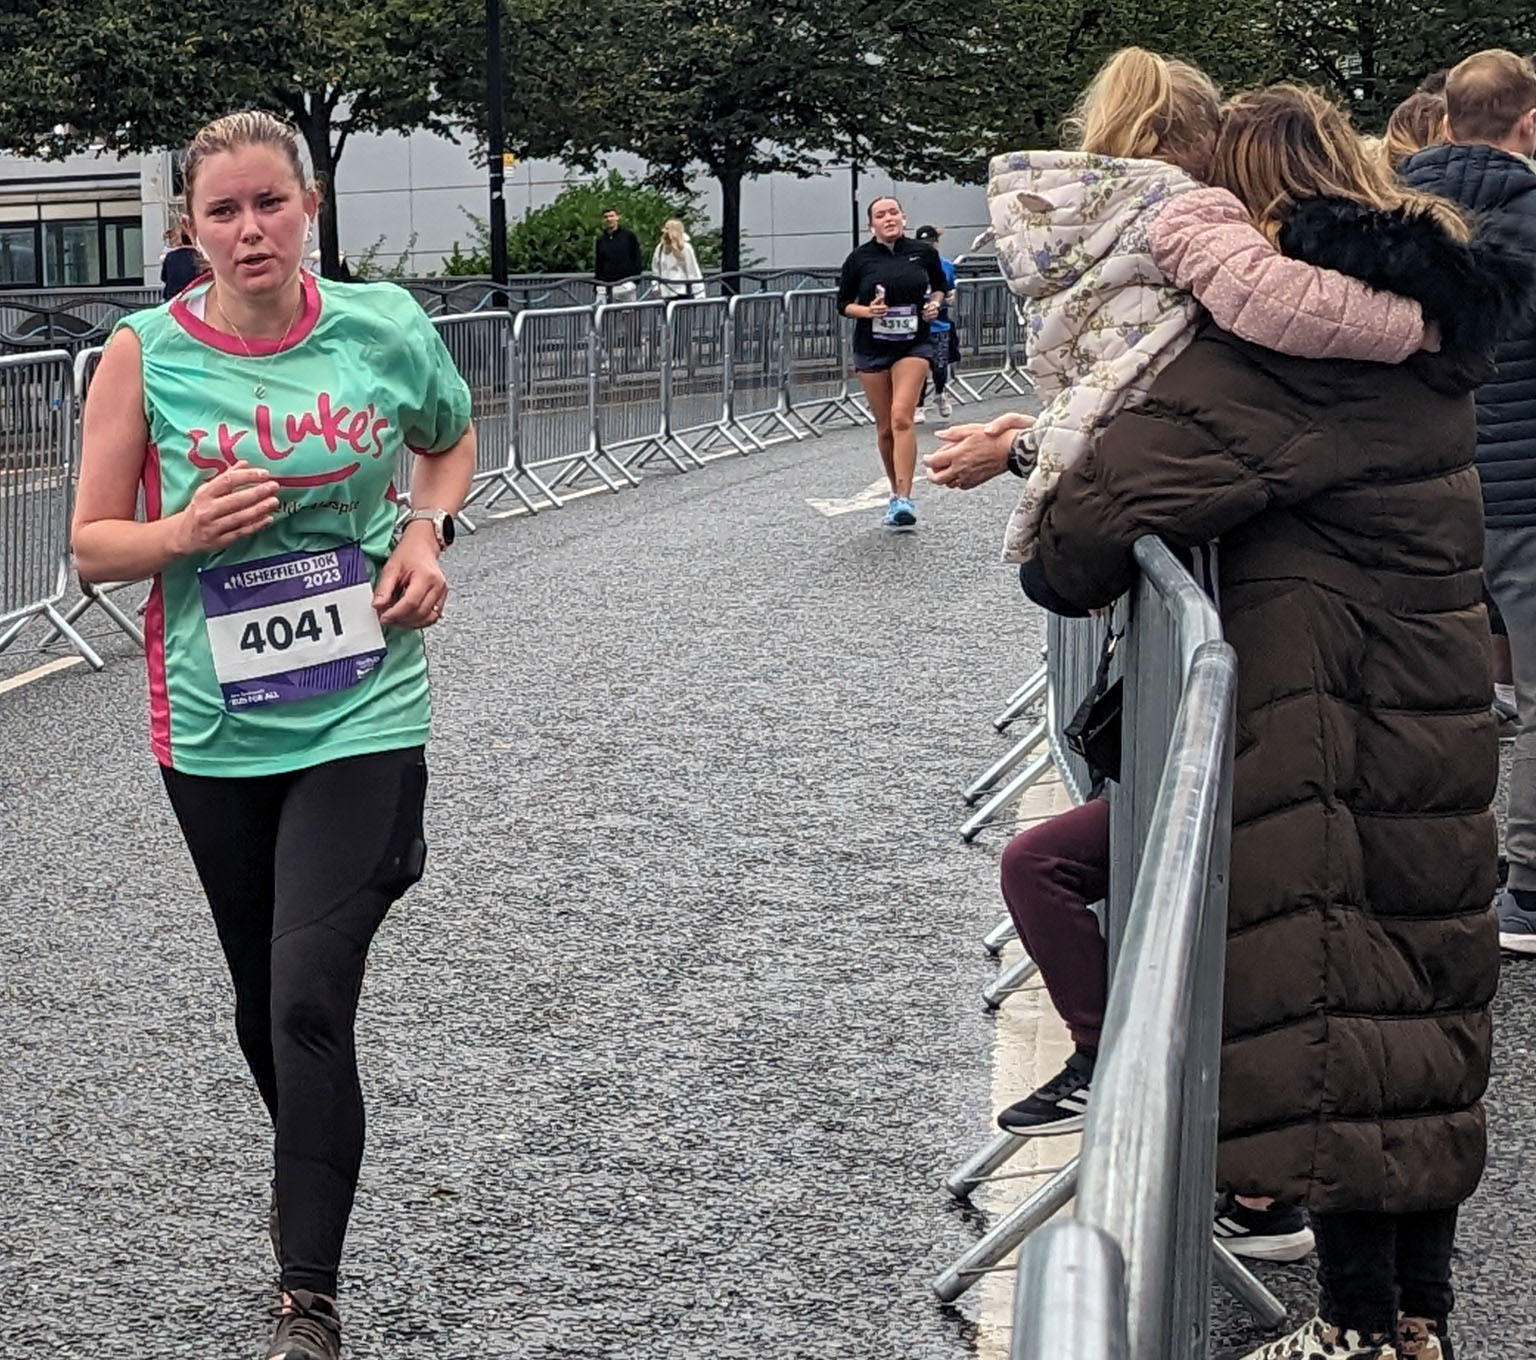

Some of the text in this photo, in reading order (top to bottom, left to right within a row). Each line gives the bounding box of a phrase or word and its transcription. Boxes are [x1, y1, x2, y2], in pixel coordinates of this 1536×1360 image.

[256, 393, 389, 459] Luke's
[245, 553, 337, 585] SHEFFIELD 10K
[303, 569, 342, 589] 2023
[240, 603, 344, 654] 4041
